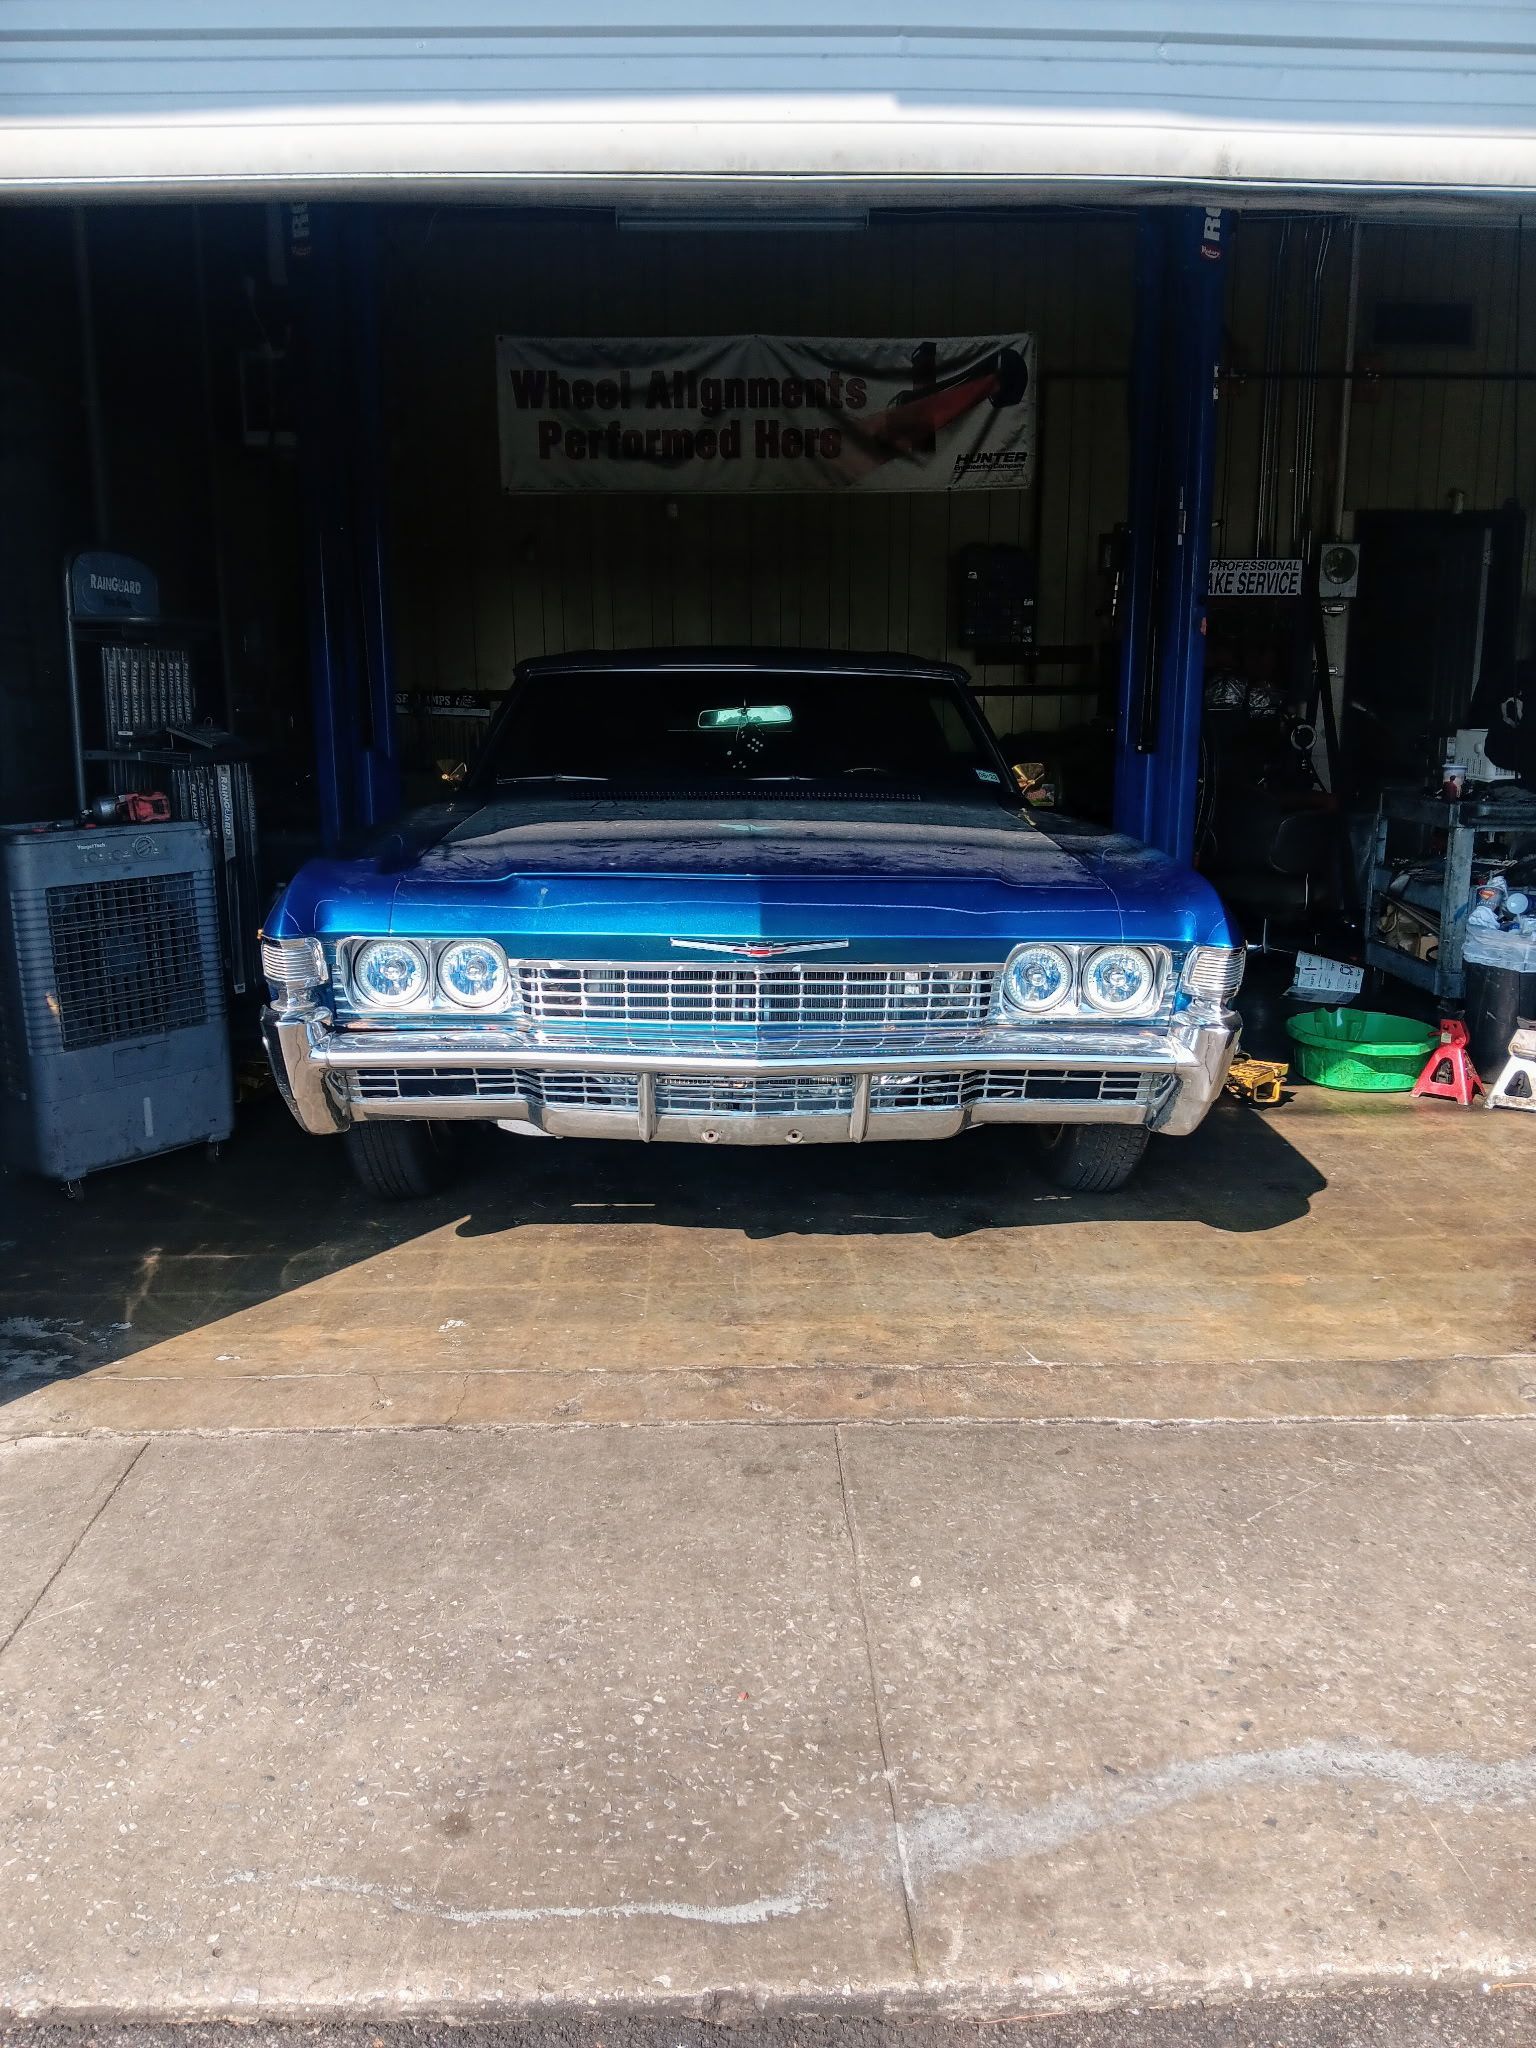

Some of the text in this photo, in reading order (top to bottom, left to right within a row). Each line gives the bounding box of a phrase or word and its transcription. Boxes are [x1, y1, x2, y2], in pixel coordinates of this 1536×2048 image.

[510, 369, 867, 418] Wheel Alignments
[538, 419, 842, 459] Performed Here
[955, 451, 1028, 464] HUNTER
[1209, 561, 1300, 572] PROFESSIONAL
[1237, 571, 1299, 594] SERVICE
[220, 776, 232, 836] RAINGUARD
